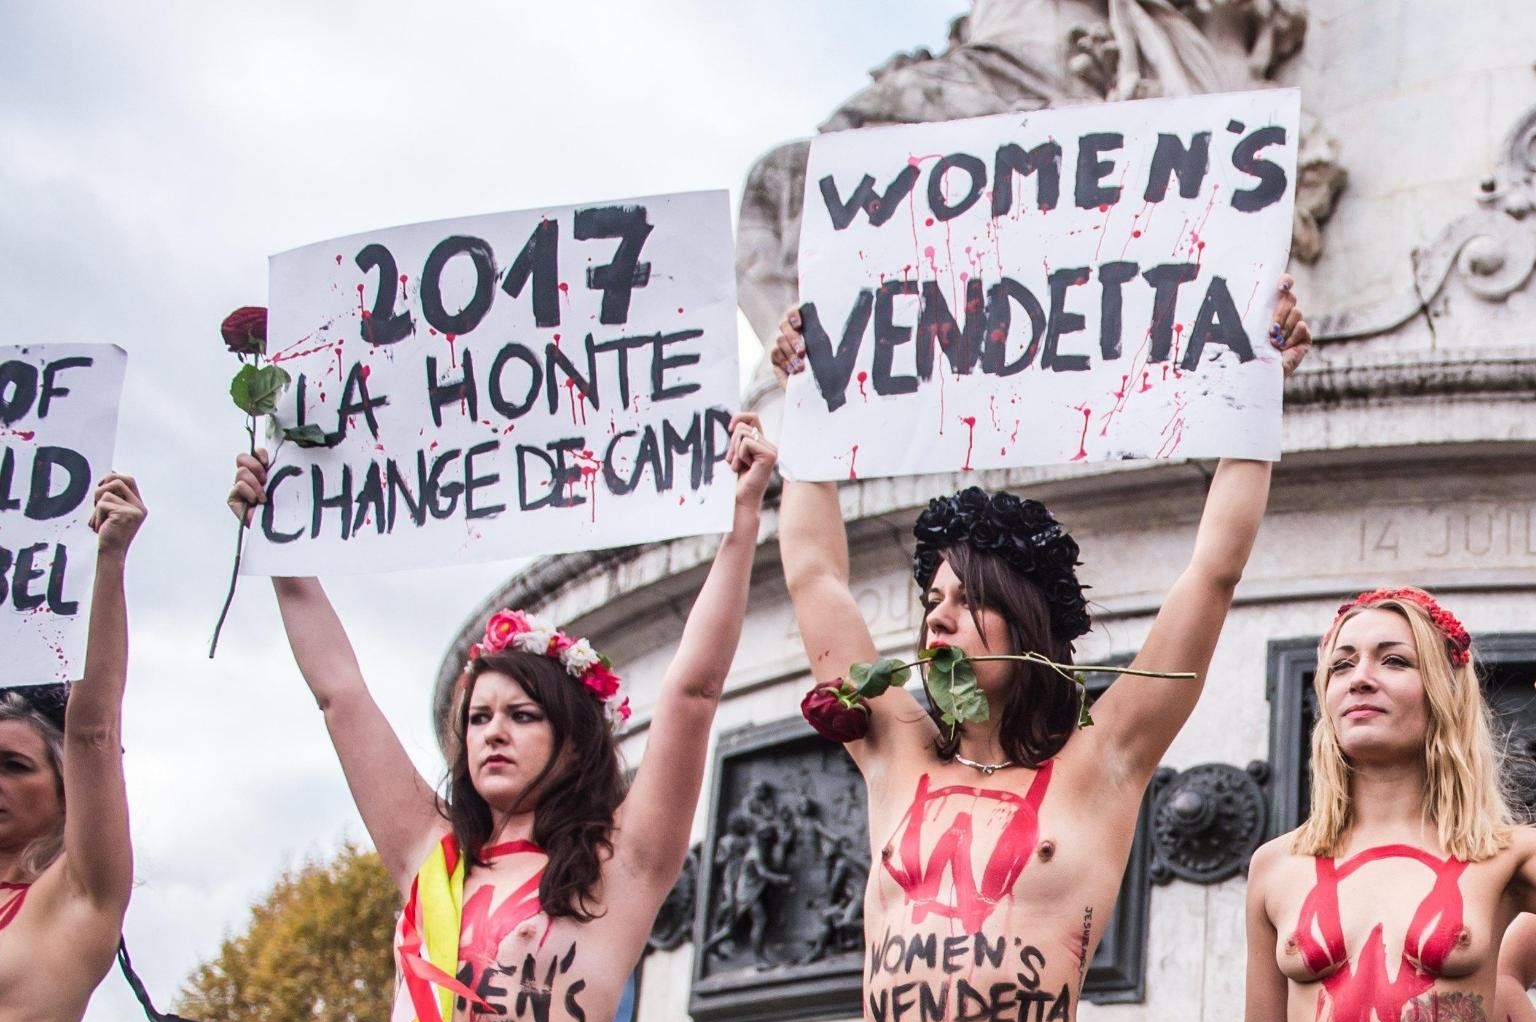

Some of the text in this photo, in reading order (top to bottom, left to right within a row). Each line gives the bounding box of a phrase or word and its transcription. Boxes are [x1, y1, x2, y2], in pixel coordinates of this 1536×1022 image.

[819, 119, 1287, 231] WOMEN'S
[355, 204, 655, 345] 2017
[296, 329, 704, 449] LA HONTE
[800, 261, 1256, 413] VENDETTA
[261, 409, 732, 544] CHANGE DE CAMP
[1357, 516, 1401, 562] 14
[869, 925, 1046, 991] WOMEN'S
